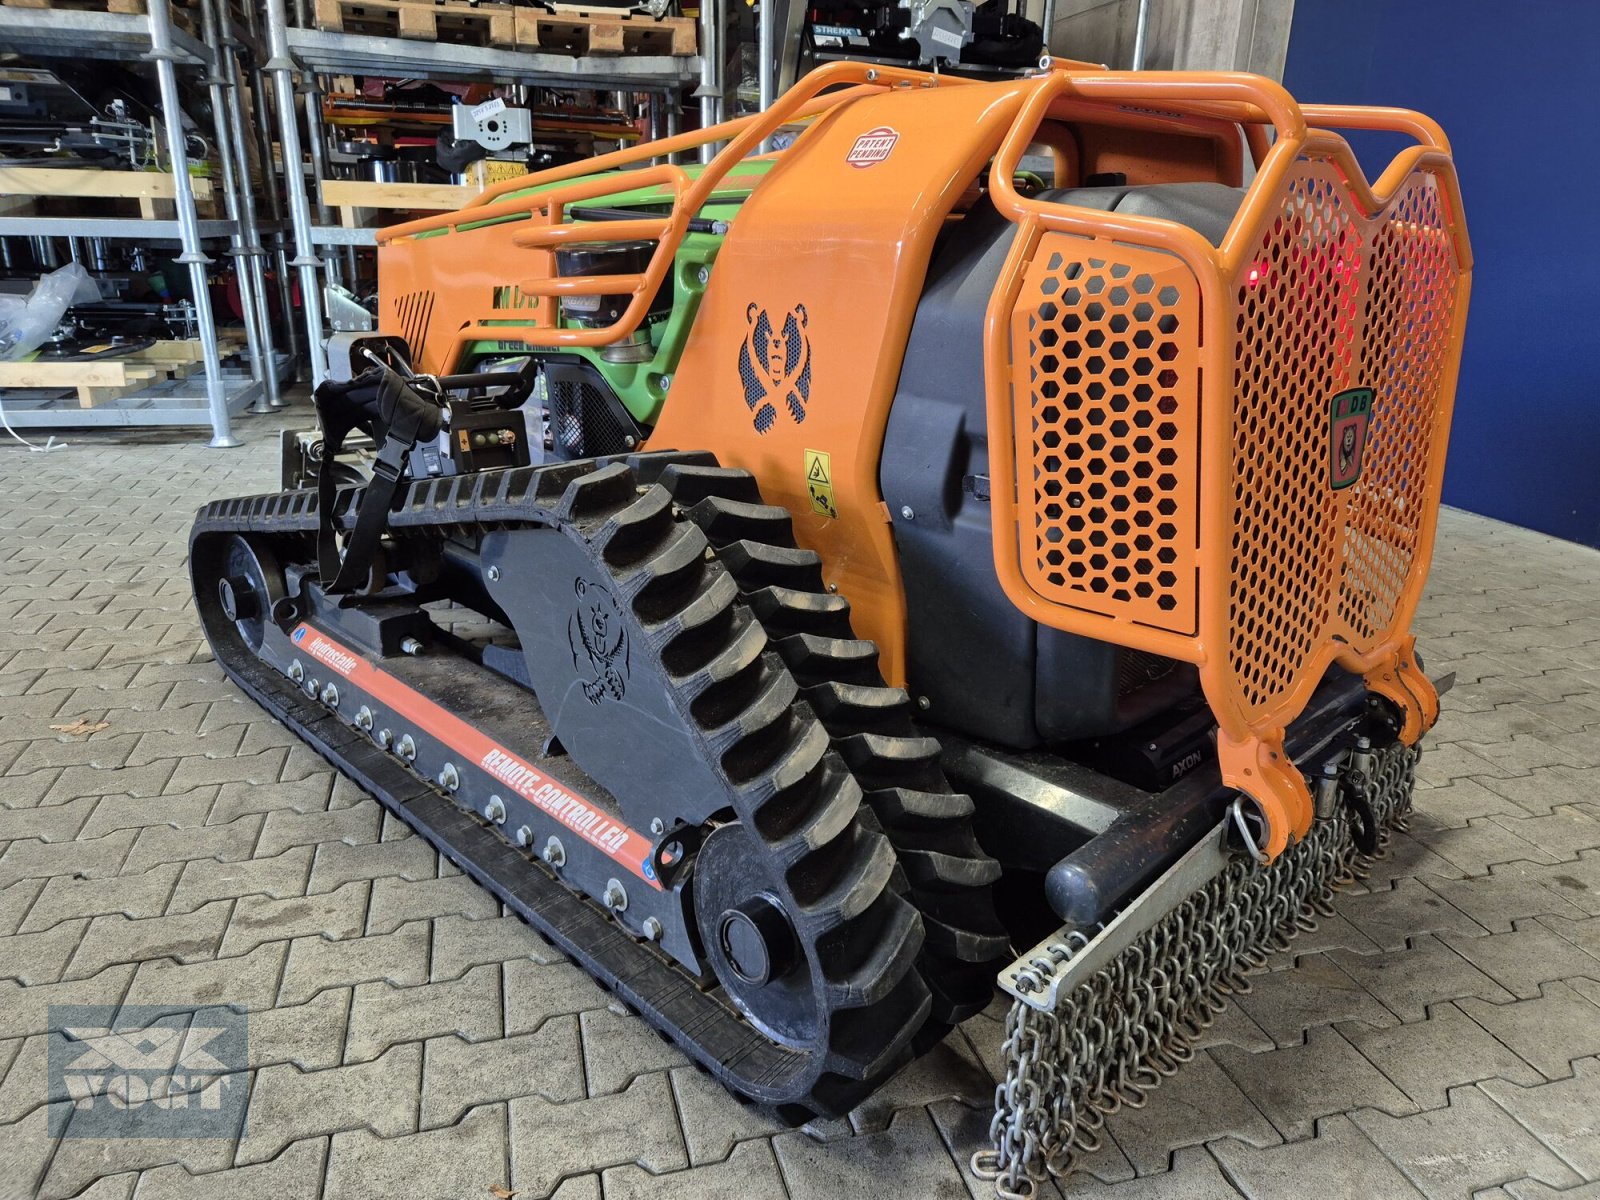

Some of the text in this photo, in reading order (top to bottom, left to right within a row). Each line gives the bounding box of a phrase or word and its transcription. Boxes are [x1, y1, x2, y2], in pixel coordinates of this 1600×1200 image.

[815, 25, 852, 36] STRENX
[856, 138, 894, 149] PATENT
[849, 149, 887, 159] PENDING
[308, 636, 358, 676] Hydrostatic
[1172, 750, 1202, 779] AXON
[480, 748, 630, 855] REMOTE-CONTROLLED
